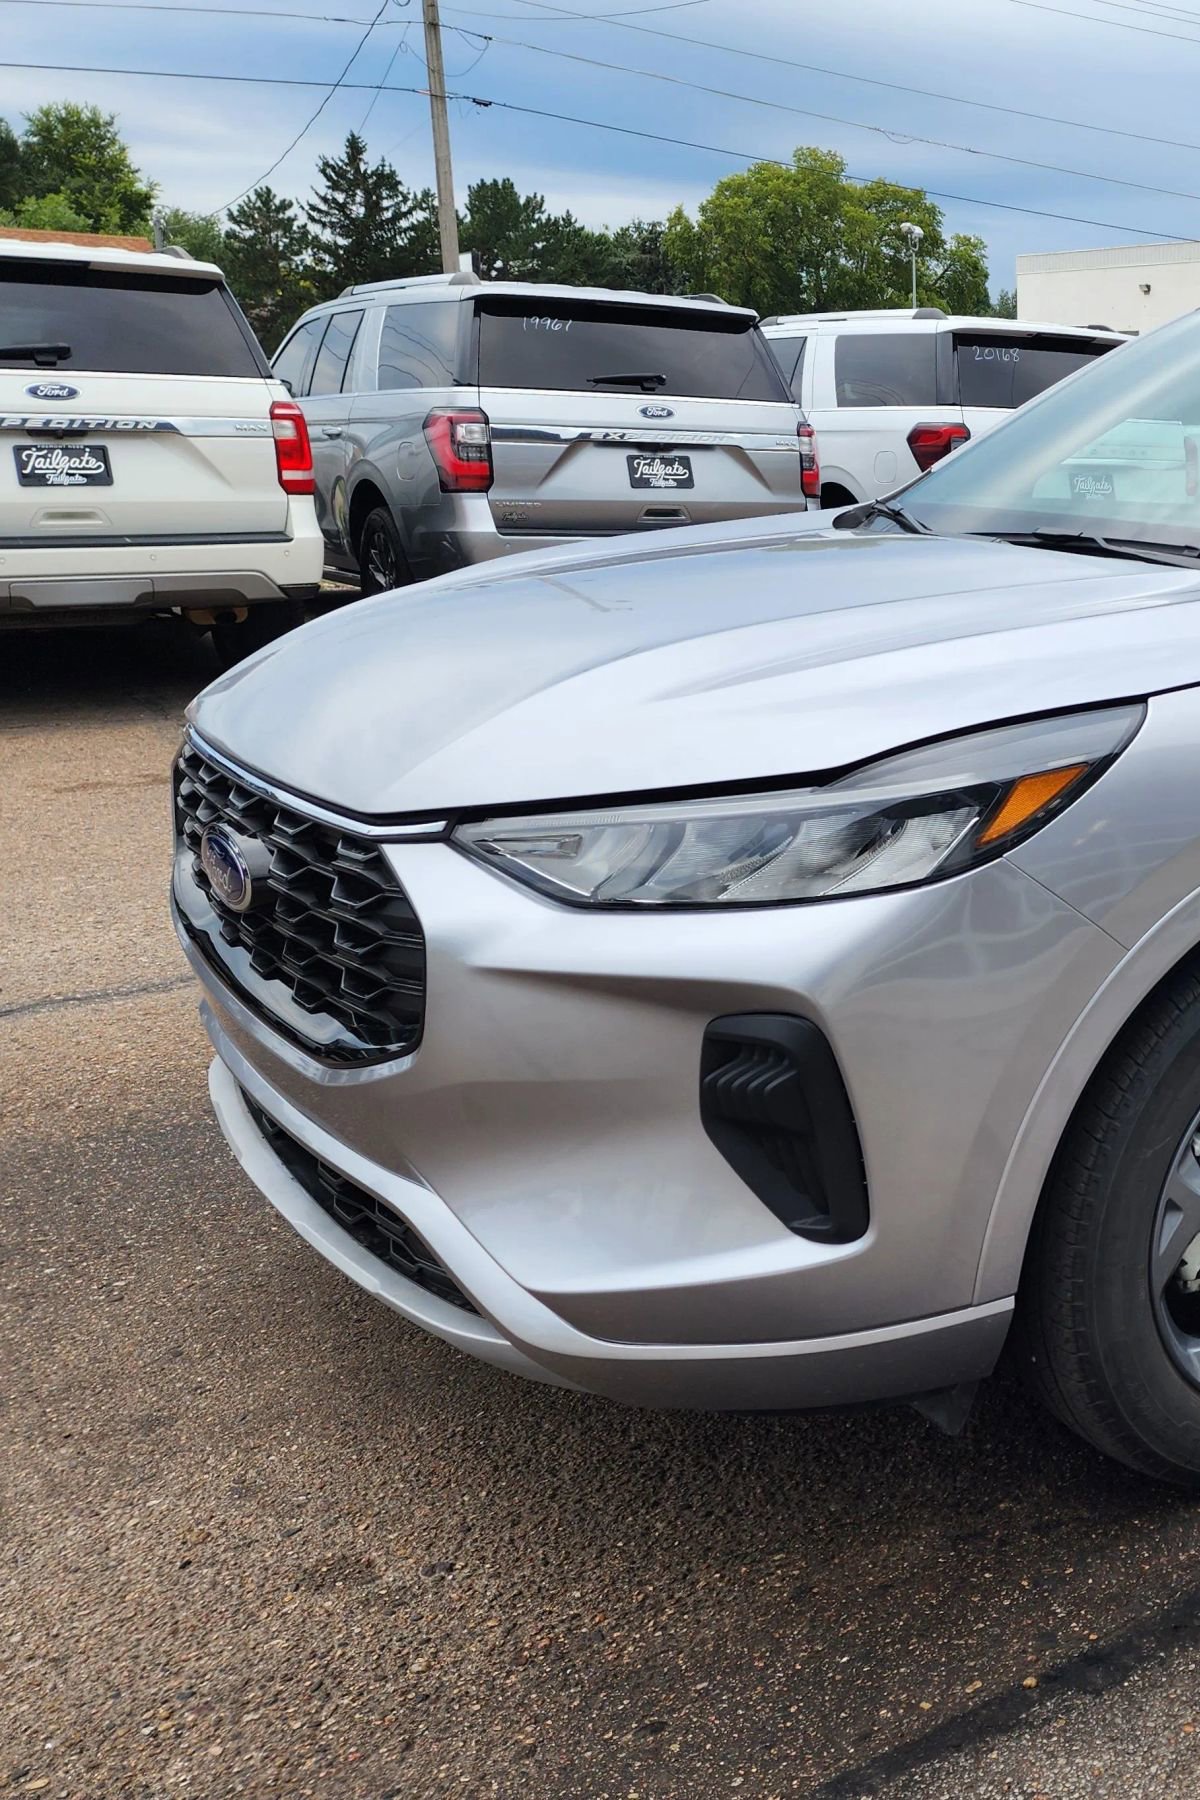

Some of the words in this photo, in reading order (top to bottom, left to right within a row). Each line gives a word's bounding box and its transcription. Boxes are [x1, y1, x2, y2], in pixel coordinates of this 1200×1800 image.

[972, 345, 1020, 362] 20168
[37, 385, 69, 397] Ford
[646, 405, 668, 417] Ford
[590, 432, 727, 444] EXPEDITION
[22, 449, 105, 475] Tailgate
[634, 459, 689, 480] Tailgate
